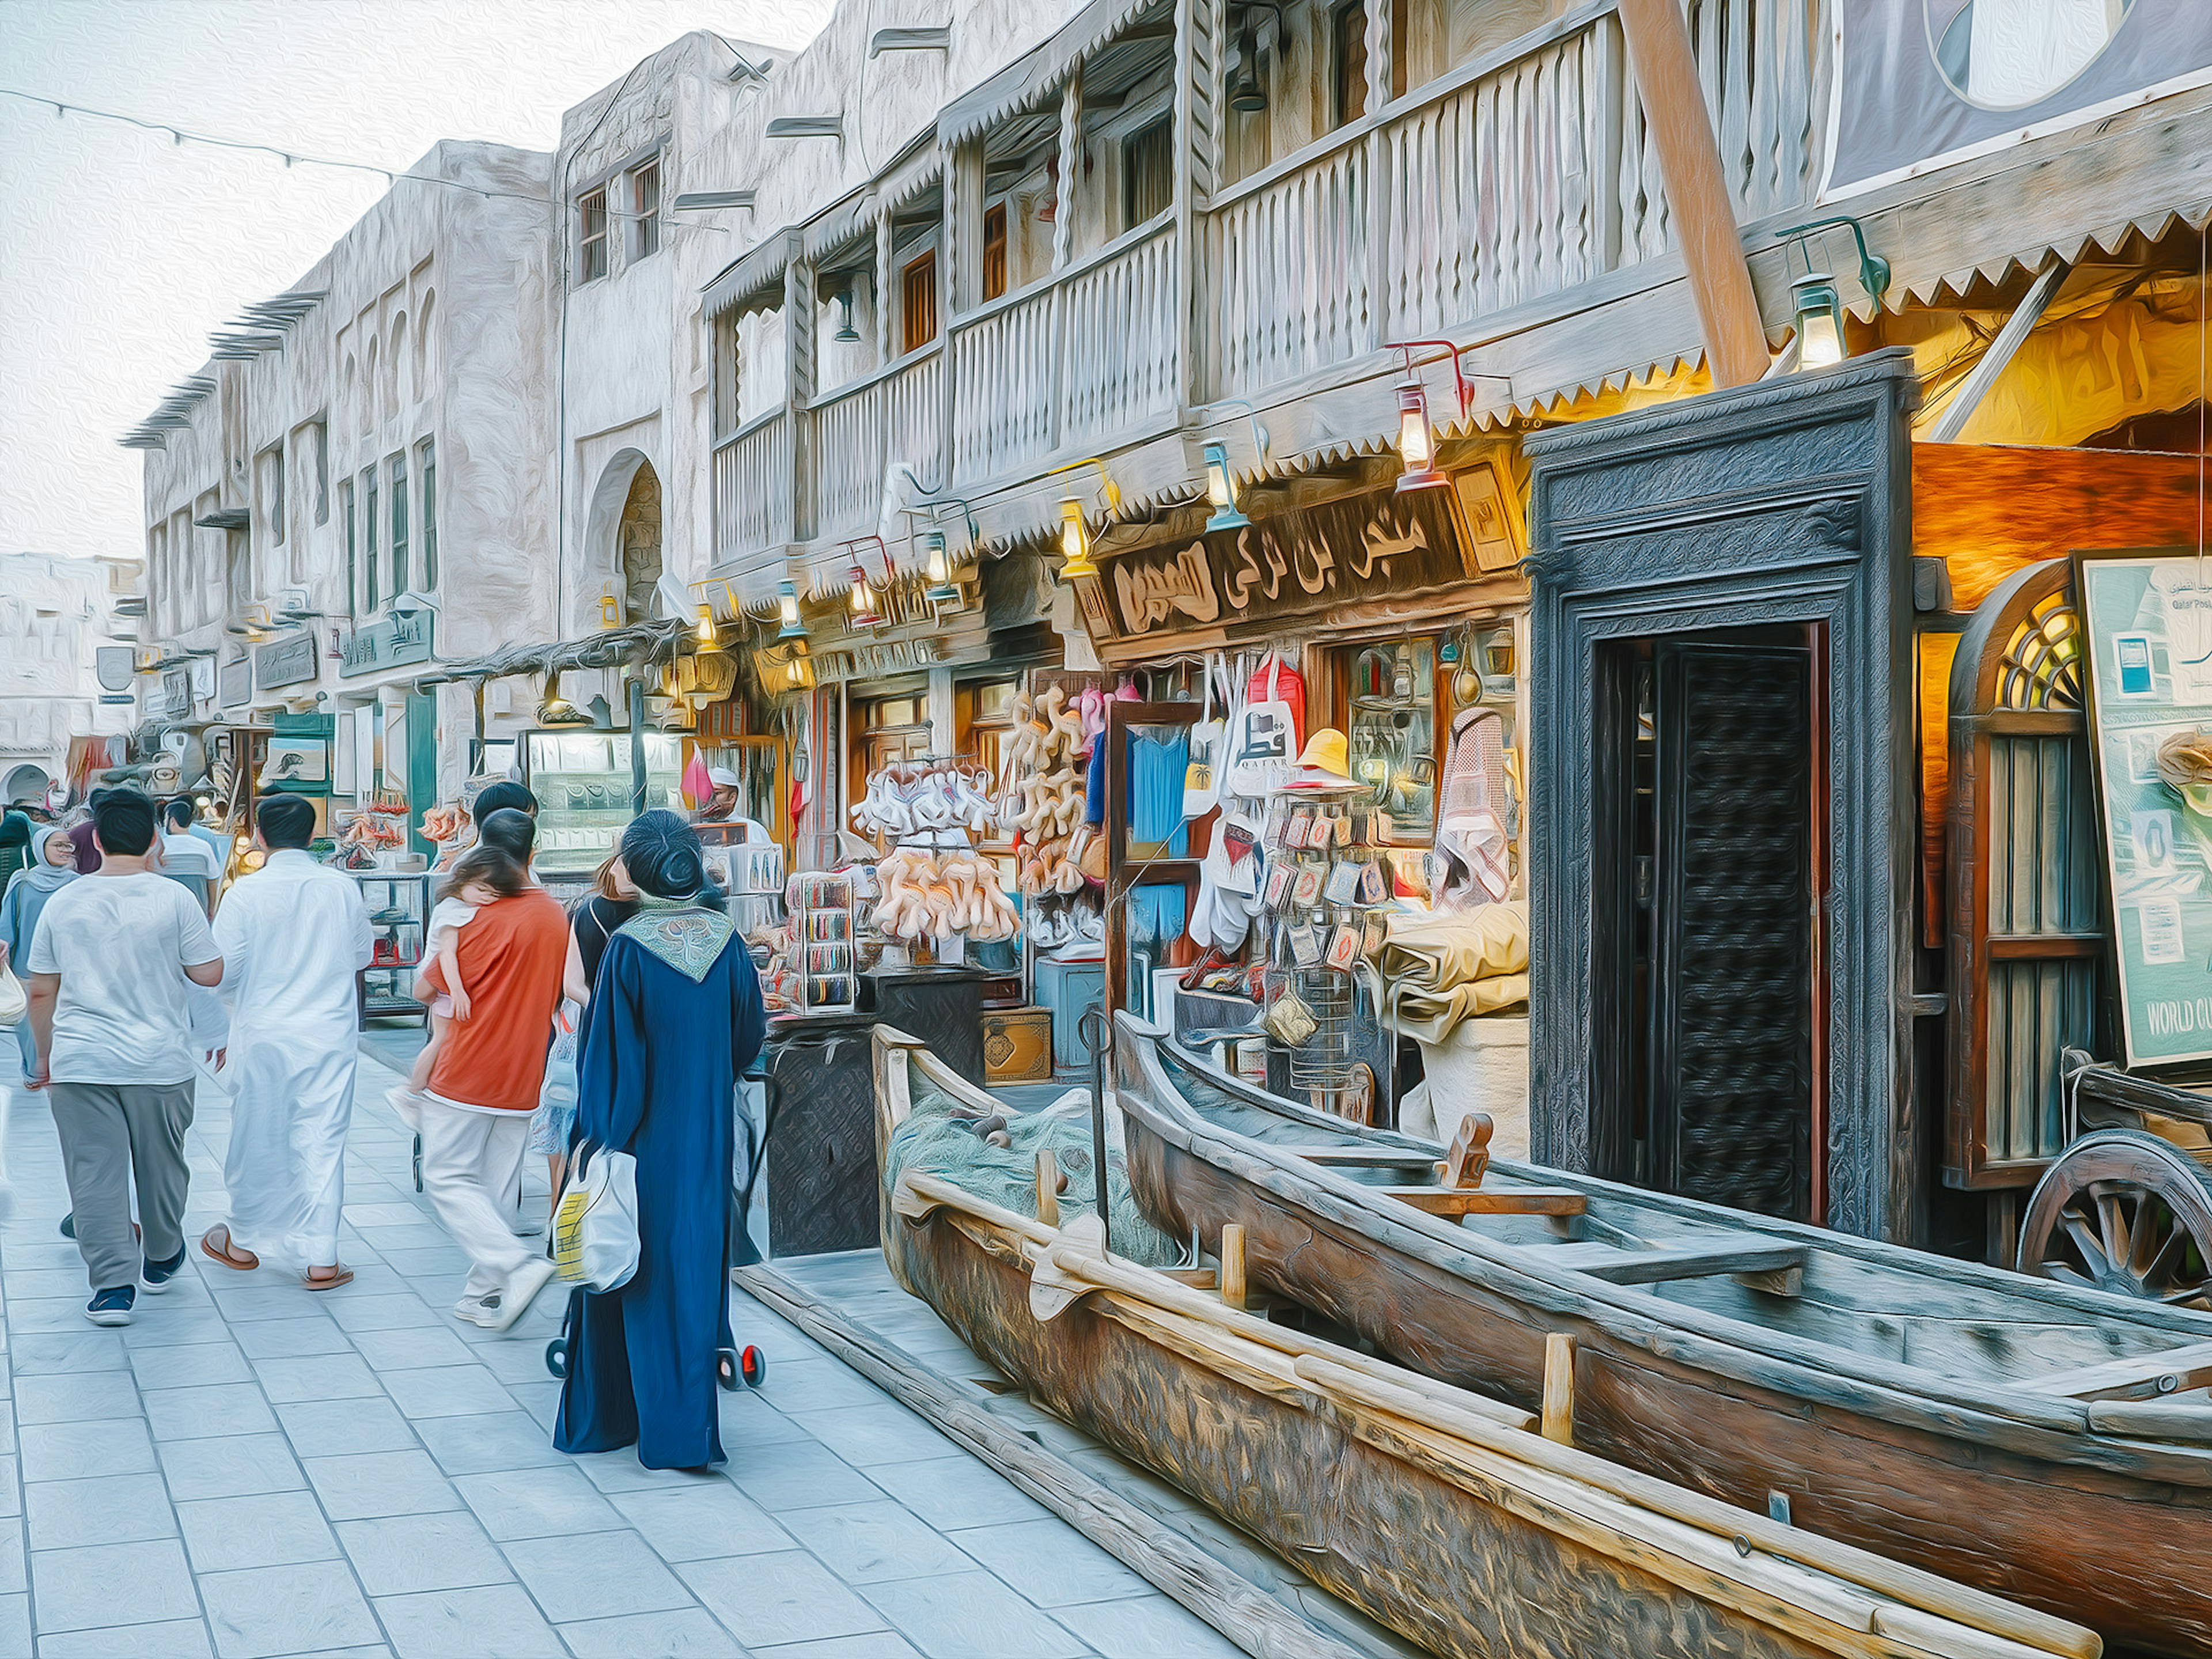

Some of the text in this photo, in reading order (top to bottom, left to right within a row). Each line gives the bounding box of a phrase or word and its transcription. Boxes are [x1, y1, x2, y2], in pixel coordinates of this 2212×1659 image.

[1224, 527, 1289, 617] تركي
[1293, 528, 1336, 594] بن
[1349, 507, 1429, 579] متجر
[1241, 758, 1288, 770] QATAR
[2147, 1001, 2194, 1035] WORLD
